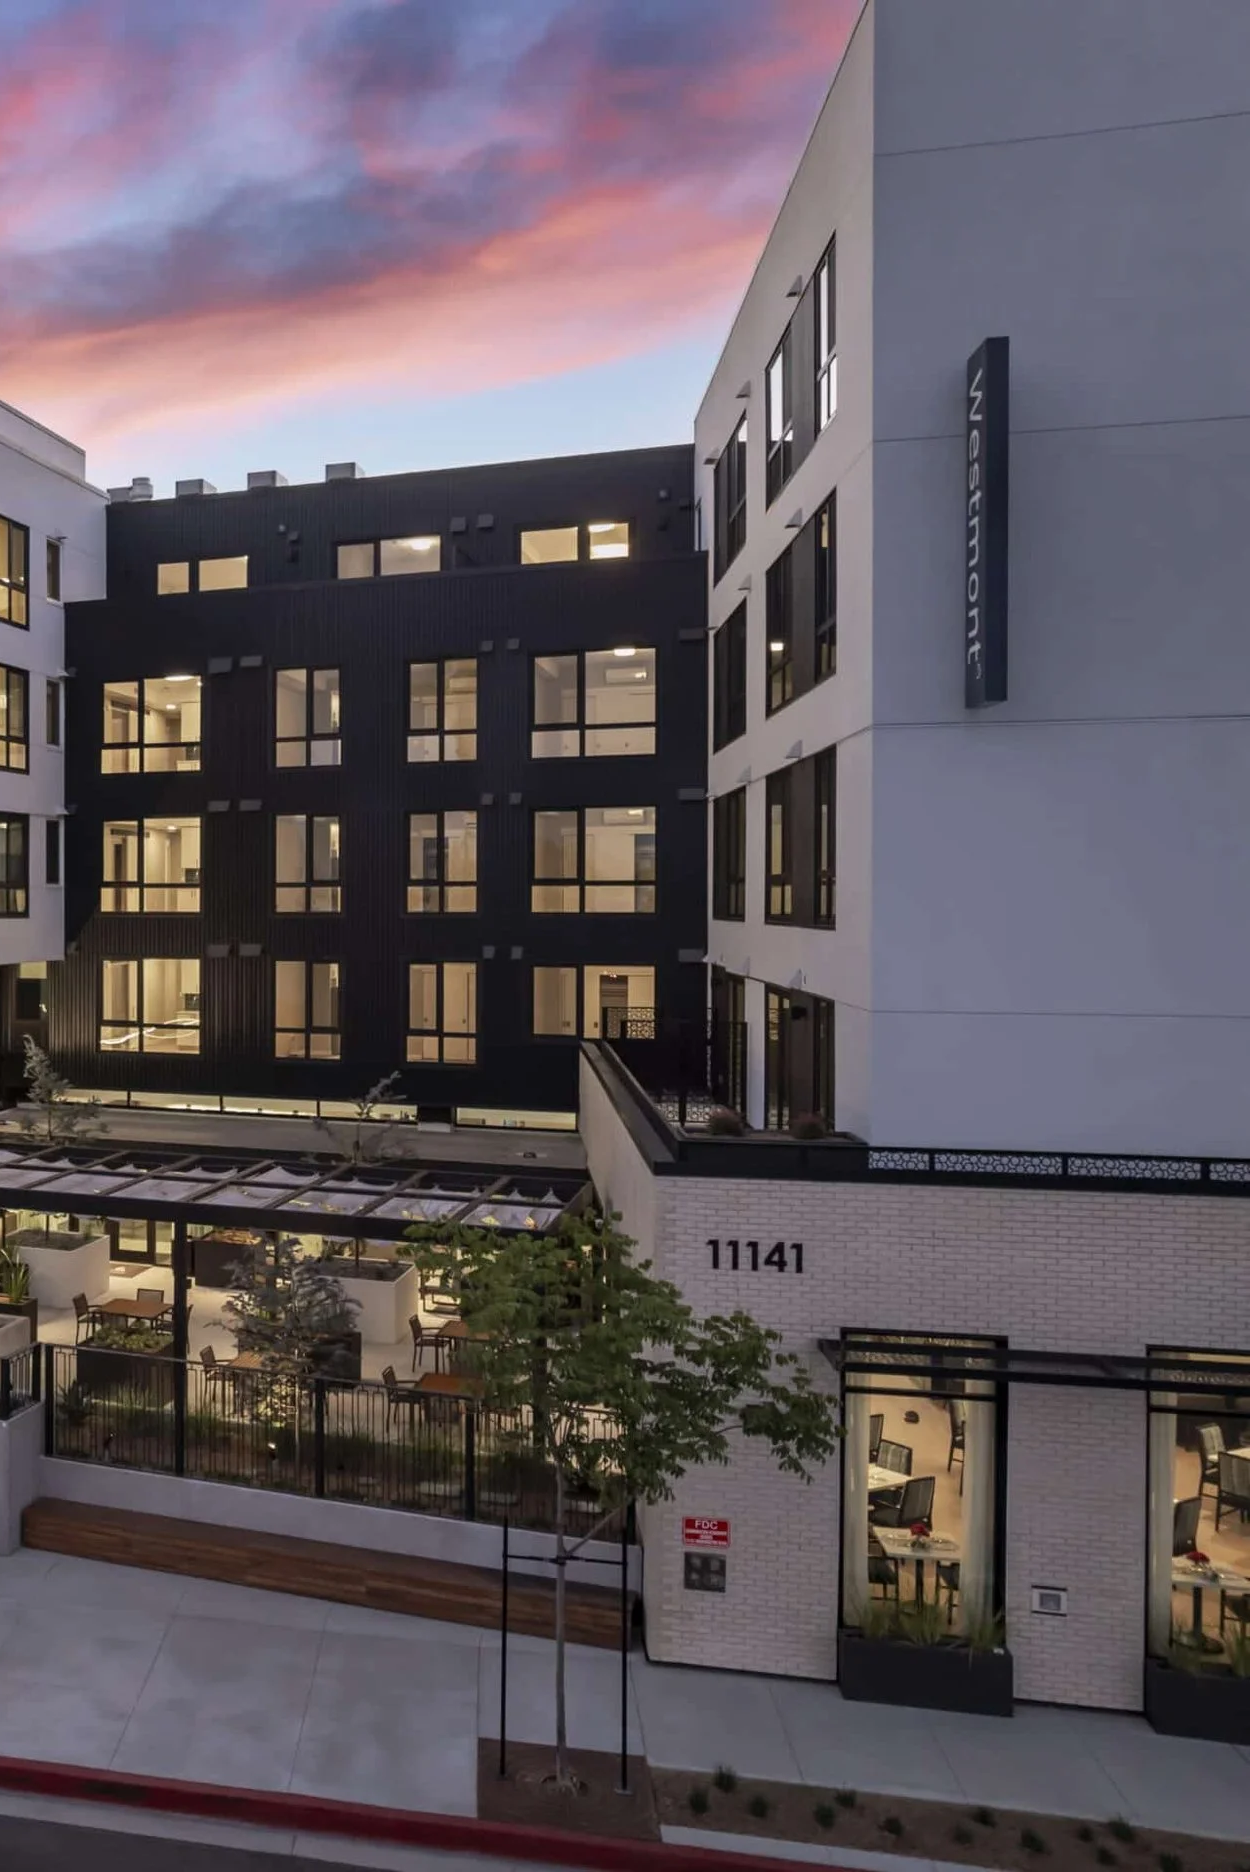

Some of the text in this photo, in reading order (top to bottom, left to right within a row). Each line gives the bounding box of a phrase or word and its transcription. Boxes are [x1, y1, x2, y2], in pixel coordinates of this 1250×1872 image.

[967, 368, 983, 666] Westmont
[705, 1239, 804, 1274] 11141
[694, 1520, 718, 1530] FDC
